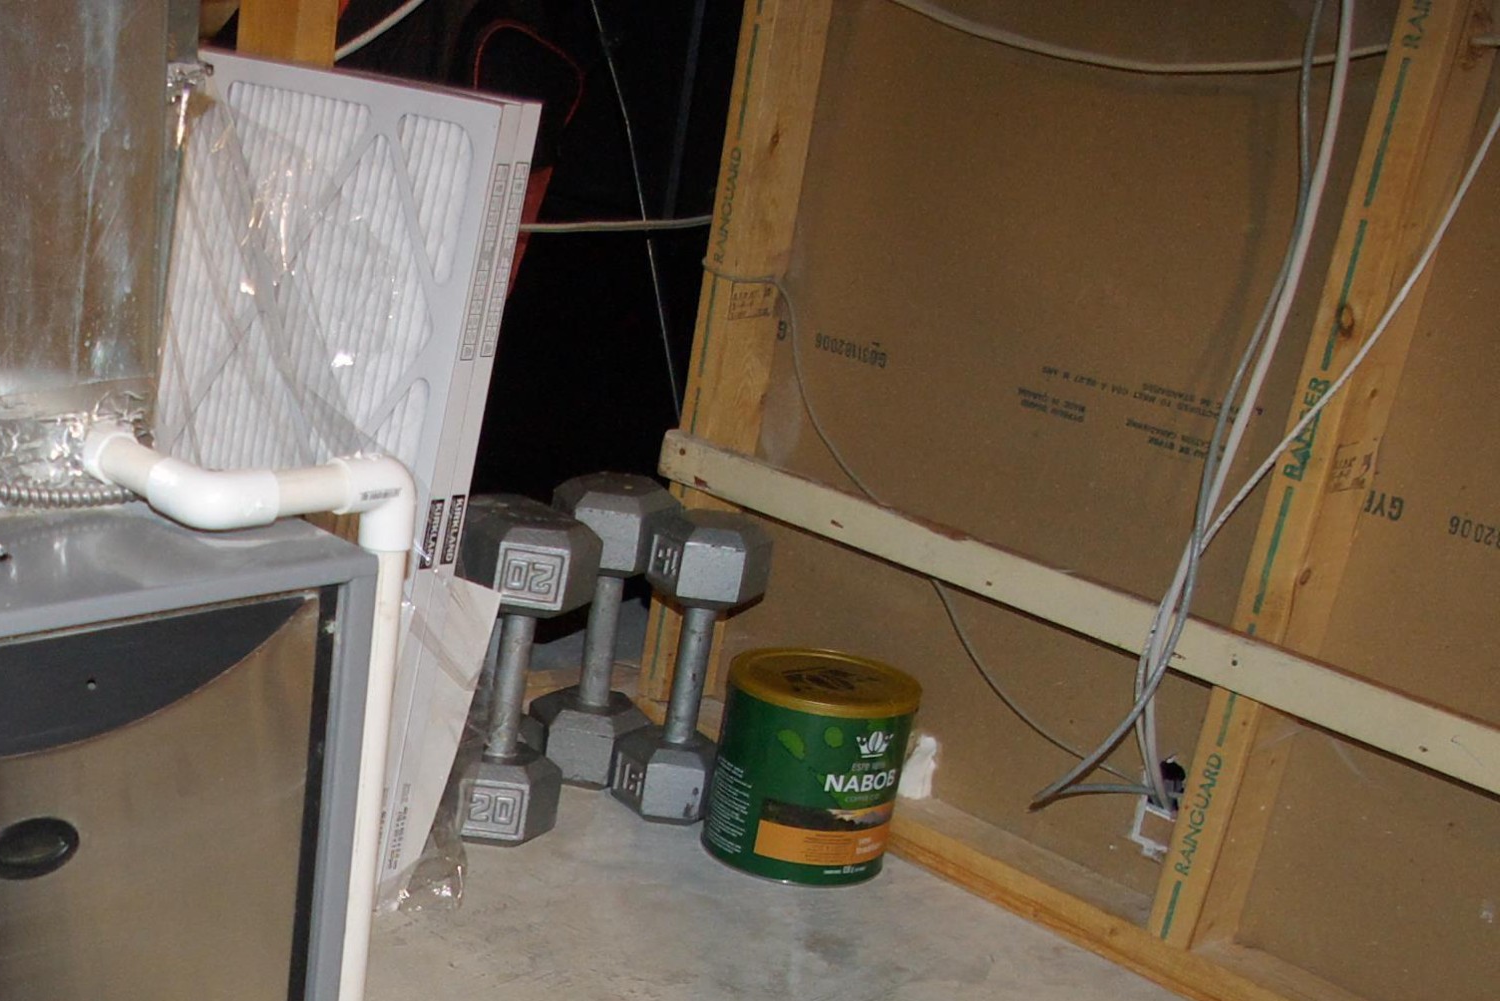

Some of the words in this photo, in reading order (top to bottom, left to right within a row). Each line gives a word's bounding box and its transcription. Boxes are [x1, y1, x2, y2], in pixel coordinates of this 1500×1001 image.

[445, 498, 464, 562] KIRKLAND
[507, 558, 556, 595] 20
[824, 769, 896, 792] NABOB
[469, 794, 516, 821] 20
[1176, 752, 1224, 877] RAINGUARD
